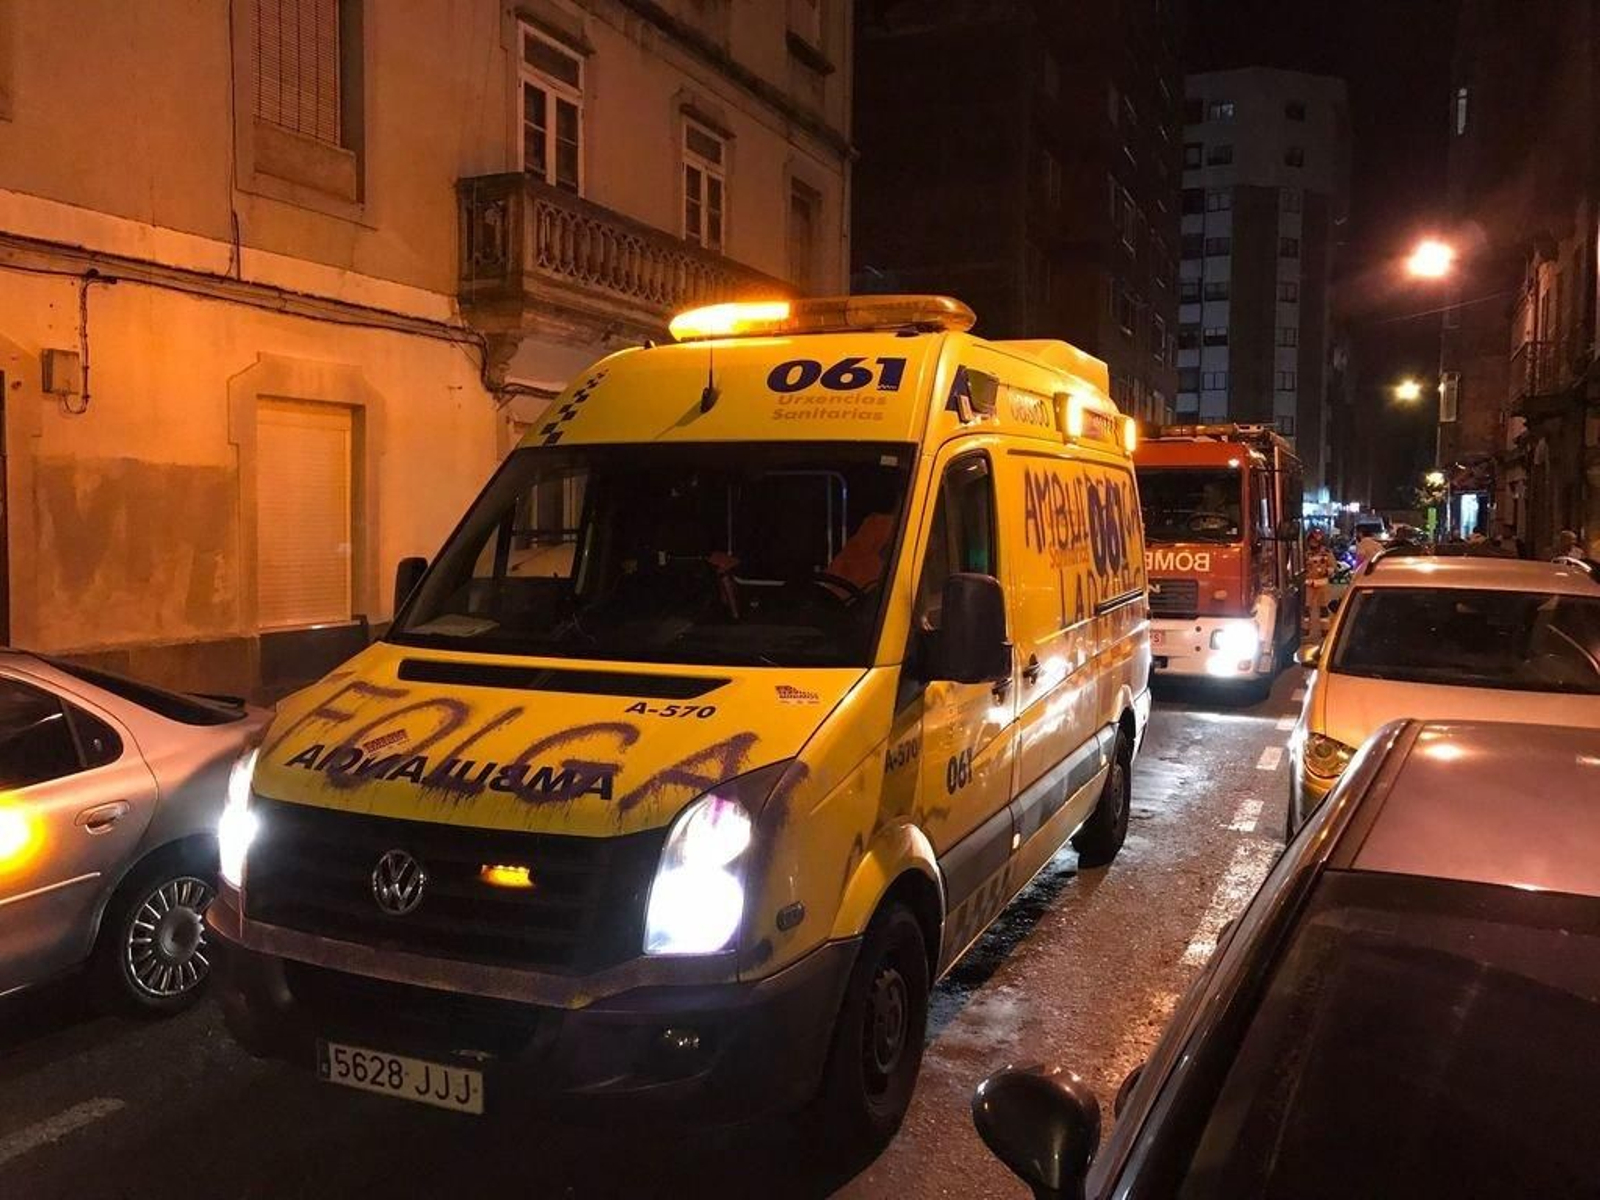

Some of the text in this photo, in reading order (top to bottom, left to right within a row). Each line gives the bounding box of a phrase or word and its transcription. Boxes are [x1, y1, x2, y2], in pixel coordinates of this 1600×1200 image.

[766, 357, 907, 393] 061
[773, 408, 885, 421] Sanitarias
[777, 393, 888, 407] Urxencias
[624, 701, 717, 719] A-570
[260, 680, 760, 815] FOLGA
[885, 740, 918, 772] A-570
[947, 748, 973, 795] 061
[334, 1048, 470, 1105] 5628 JJJ
